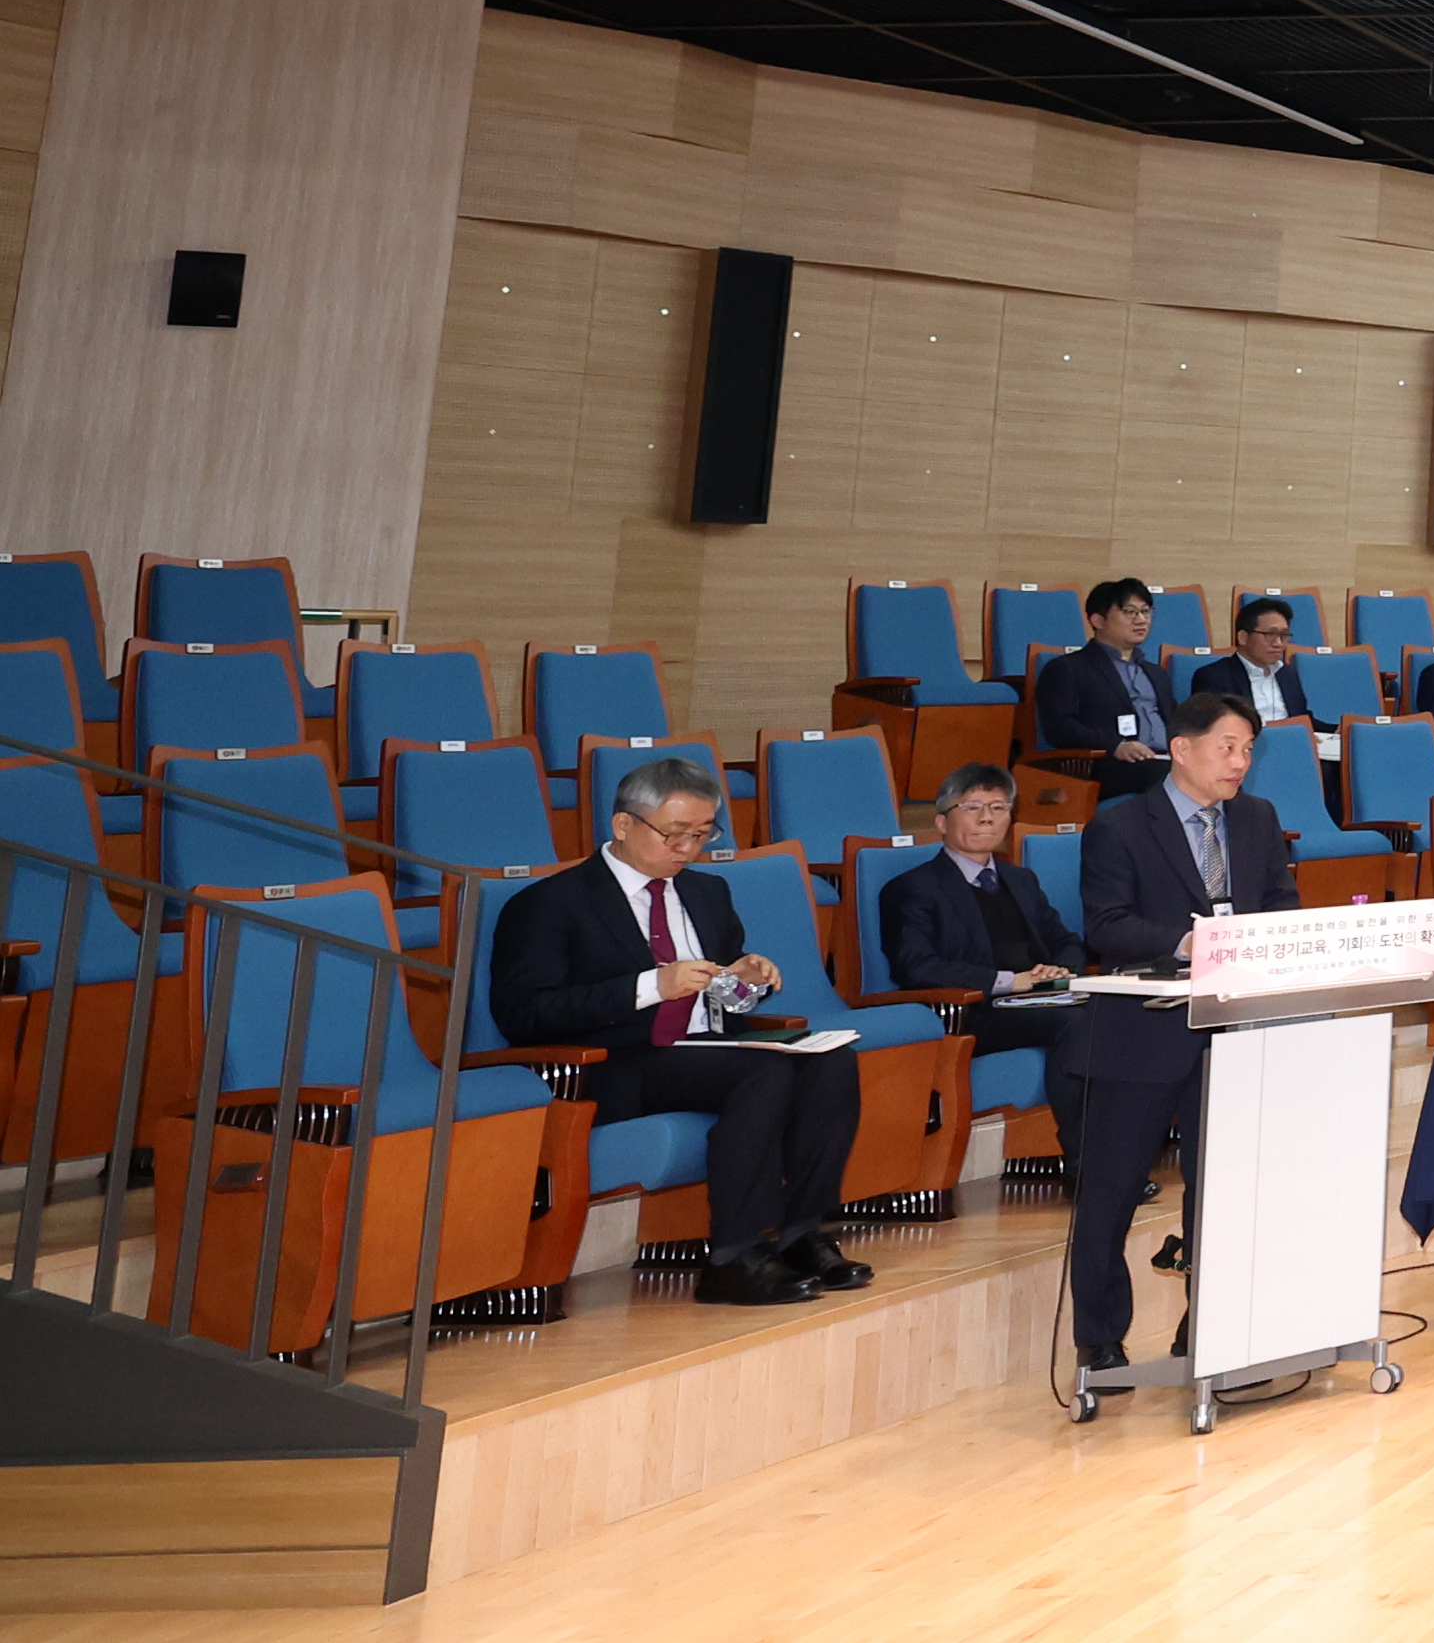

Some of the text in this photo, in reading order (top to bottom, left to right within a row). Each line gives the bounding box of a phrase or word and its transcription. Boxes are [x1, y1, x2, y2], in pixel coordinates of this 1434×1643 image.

[1209, 928, 1256, 942] 경기교육
[1266, 921, 1347, 936] 국제교류협력의
[1356, 916, 1388, 929] 발전을
[1396, 914, 1417, 925] 위한
[1208, 947, 1237, 964] 세계
[1241, 944, 1268, 961] 속의
[1272, 939, 1331, 960] 경기교육,
[1338, 935, 1376, 951] 기회와
[1379, 931, 1417, 948] 도전의
